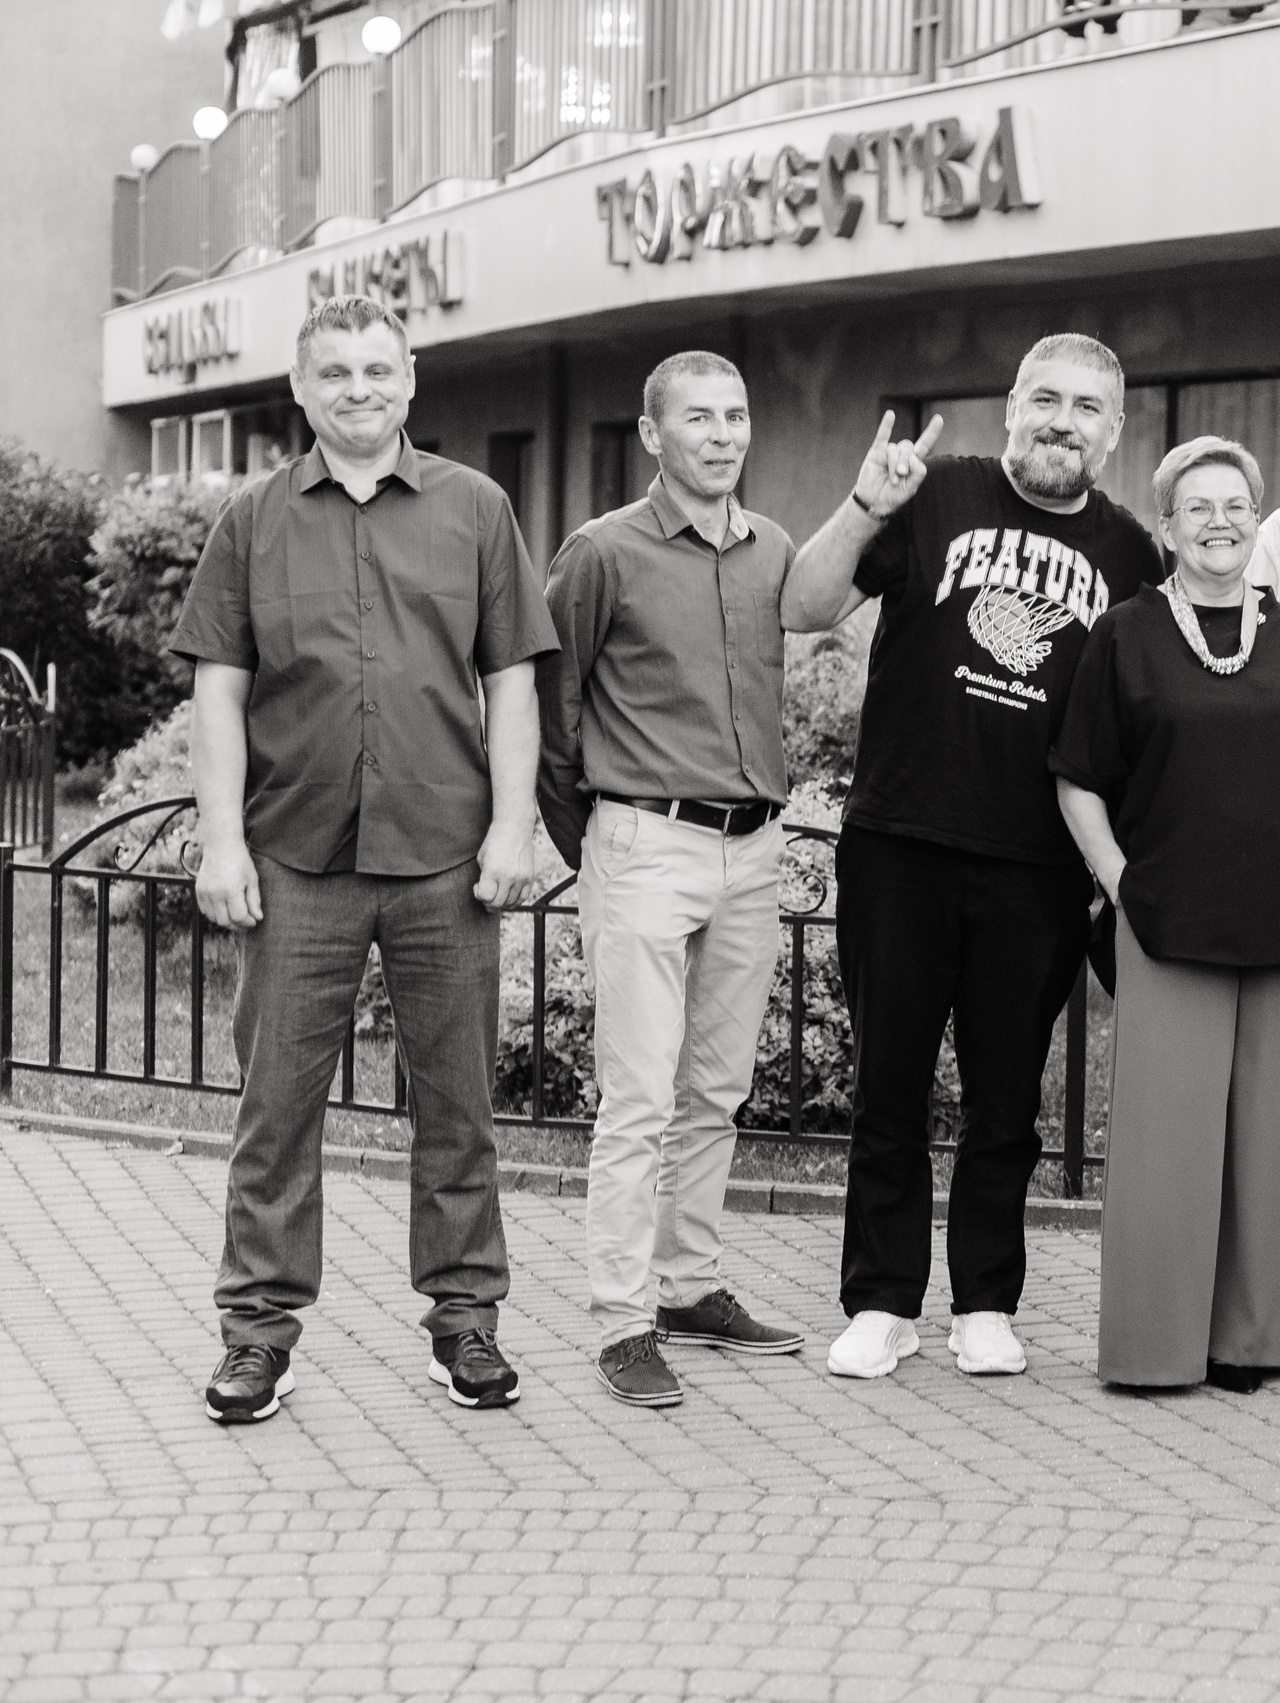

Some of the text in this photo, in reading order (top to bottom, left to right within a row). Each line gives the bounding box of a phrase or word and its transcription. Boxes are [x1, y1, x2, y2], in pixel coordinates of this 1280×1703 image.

[596, 105, 1040, 269] ТОРЖЕСТВА
[954, 665, 1047, 702] Premium Rebels
